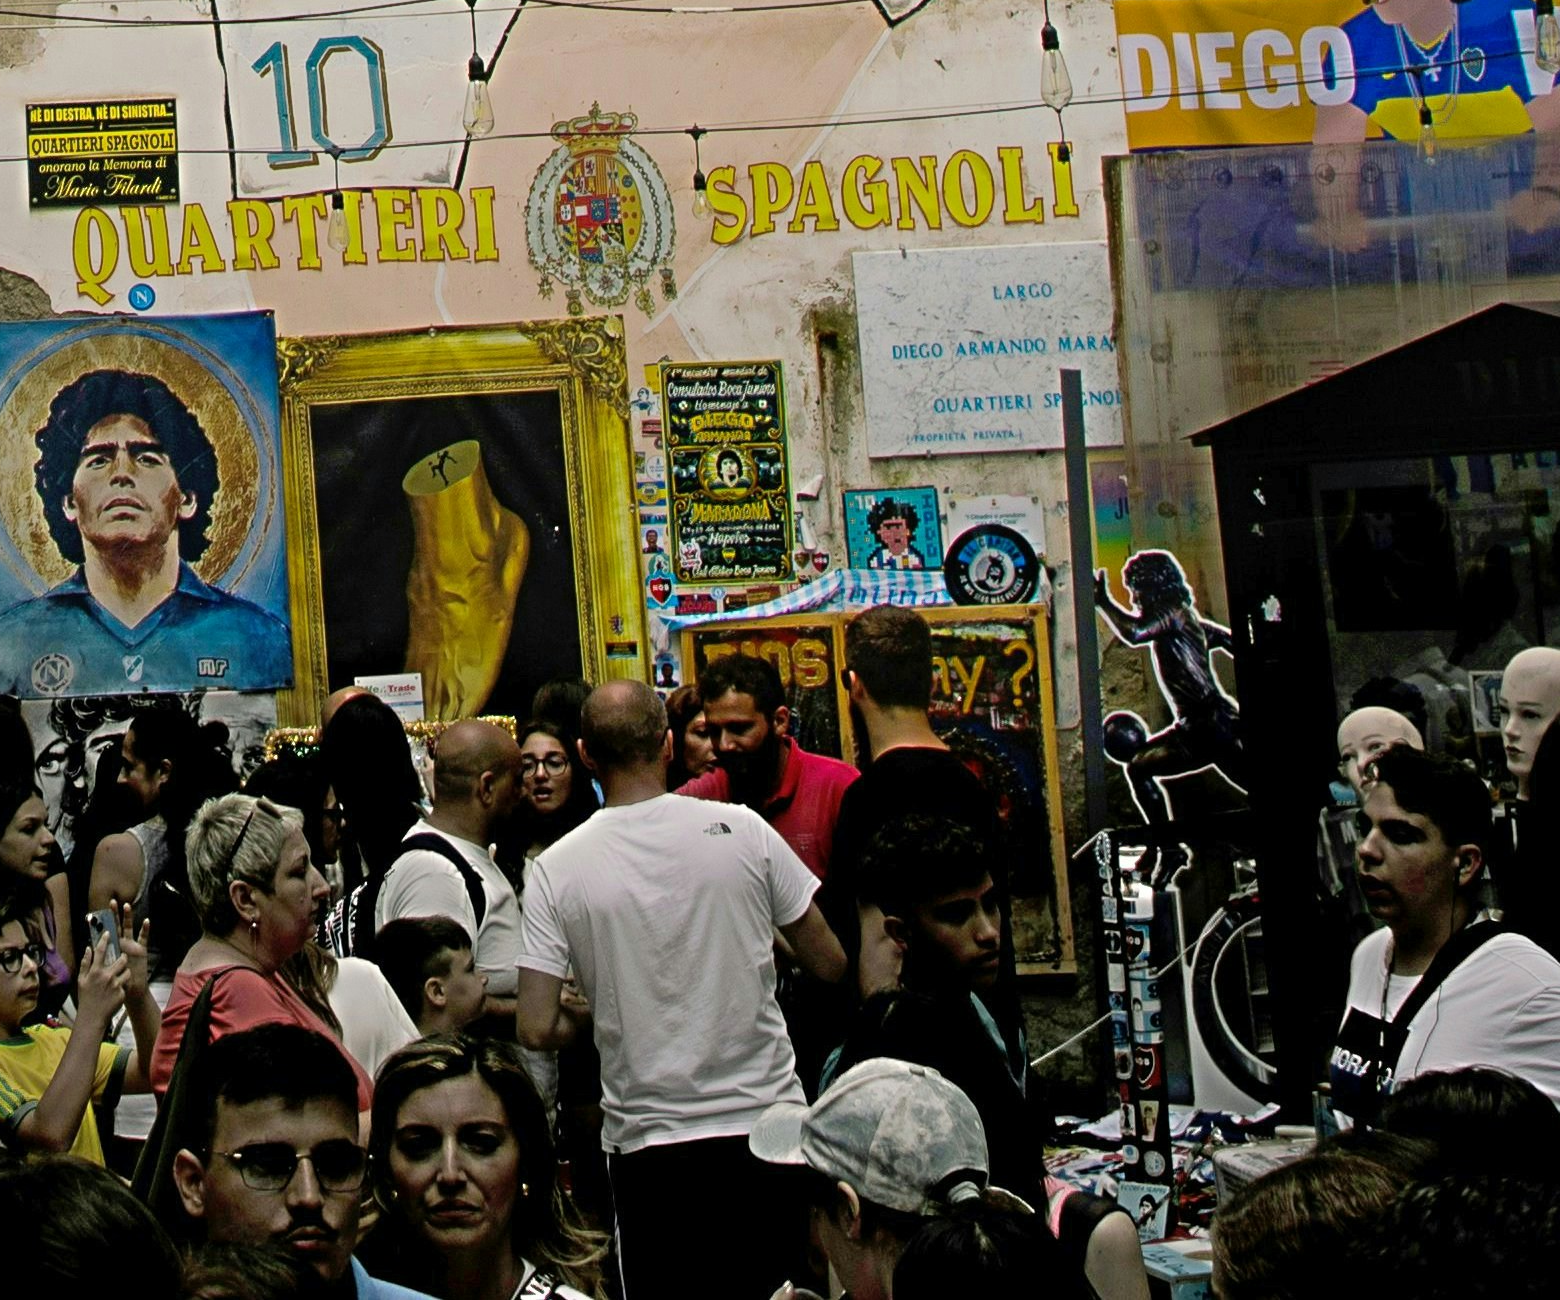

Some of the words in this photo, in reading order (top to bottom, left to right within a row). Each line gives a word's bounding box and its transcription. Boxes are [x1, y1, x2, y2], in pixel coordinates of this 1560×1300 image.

[1121, 24, 1355, 113] DIEGO
[250, 35, 394, 170] 10
[43, 108, 54, 121] DI
[55, 106, 94, 122] DESTRA,
[109, 105, 120, 118] DI
[31, 135, 104, 156] QUARTIERI
[106, 132, 174, 151] SPAGNOLI
[39, 162, 86, 173] onorano
[88, 159, 100, 171] la
[103, 157, 152, 171] Memoria
[155, 156, 167, 168] di
[44, 174, 99, 199] Mario
[103, 173, 162, 197] Filardi
[73, 185, 500, 306] QUARTIERI
[704, 140, 1080, 247] SPAGNOLI
[134, 288, 150, 306] N
[992, 282, 1053, 301] LARGO
[891, 341, 944, 361] DIEGO
[955, 336, 1047, 357] ARMANDO
[1058, 334, 1113, 352] MARA
[667, 382, 718, 398] Consulados
[719, 381, 743, 398] Boca
[740, 380, 776, 401] Juniors
[933, 393, 1033, 414] QUARTIERI
[690, 411, 756, 432] DIEGO
[690, 499, 772, 524] MARADONA
[386, 683, 417, 694] Trade
